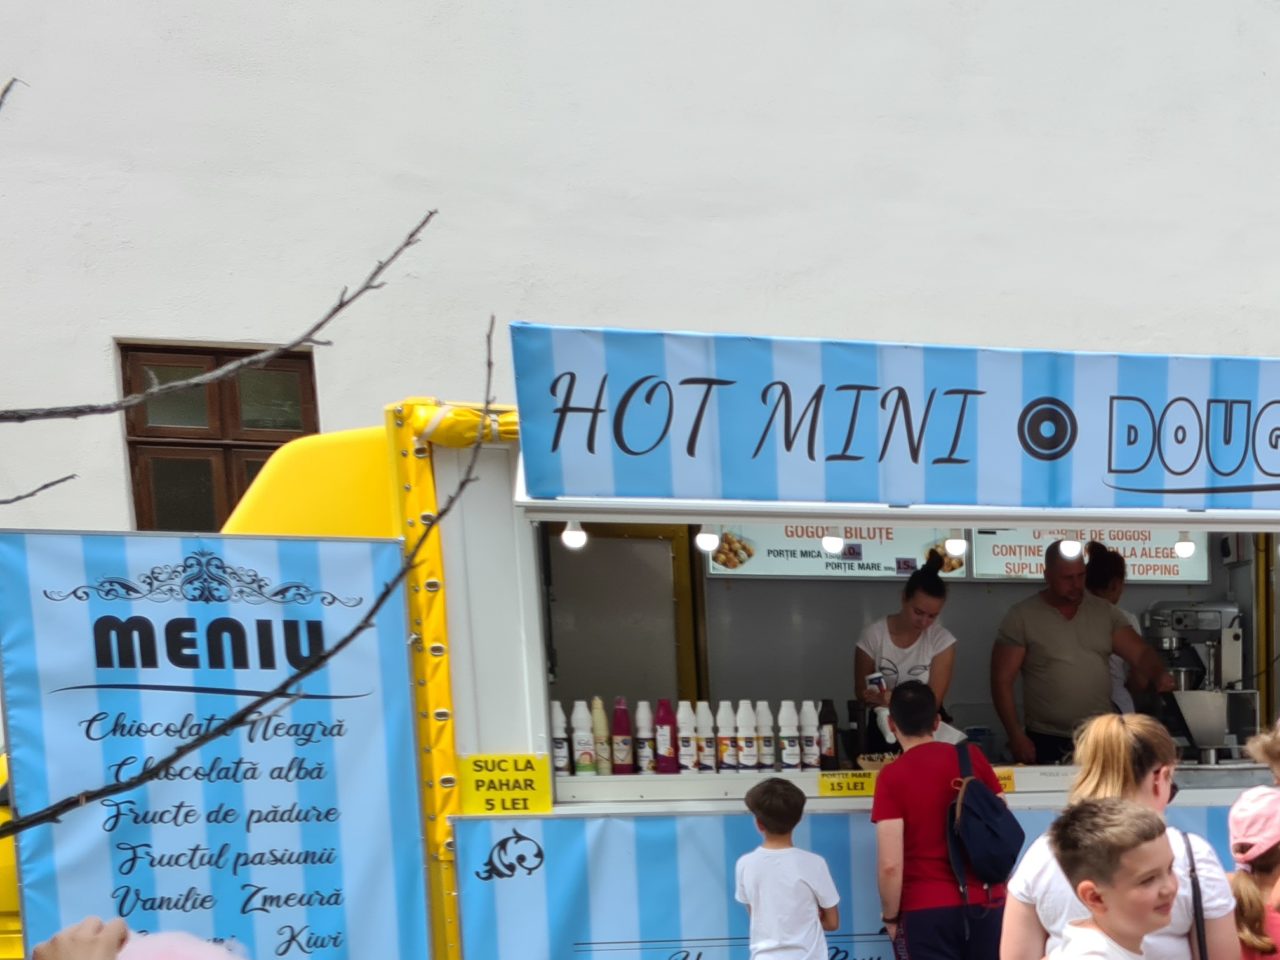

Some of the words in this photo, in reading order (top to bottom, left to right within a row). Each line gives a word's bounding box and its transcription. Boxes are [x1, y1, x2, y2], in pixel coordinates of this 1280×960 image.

[549, 371, 737, 458] HOT
[752, 380, 987, 465] MINI
[1090, 530, 1105, 541] DE
[800, 550, 823, 559] MICA
[858, 563, 882, 572] MARE
[1131, 564, 1180, 576] TOPPING
[93, 615, 327, 671] MENIU
[269, 757, 327, 784] albă
[472, 759, 509, 772] SUC
[513, 759, 536, 772] LA
[475, 778, 537, 791] PAHAR
[830, 782, 844, 791] 15
[846, 782, 866, 791] LEI
[484, 798, 496, 811] 5
[501, 798, 529, 811] LEI
[100, 799, 199, 833] Fructe
[206, 803, 240, 825] de
[246, 804, 341, 833] pădure
[116, 843, 231, 875] Fructul
[232, 847, 337, 876] pasiunii
[111, 885, 217, 917] Vanilie
[240, 884, 345, 914] Zmeură
[275, 925, 344, 956] Kiwi
